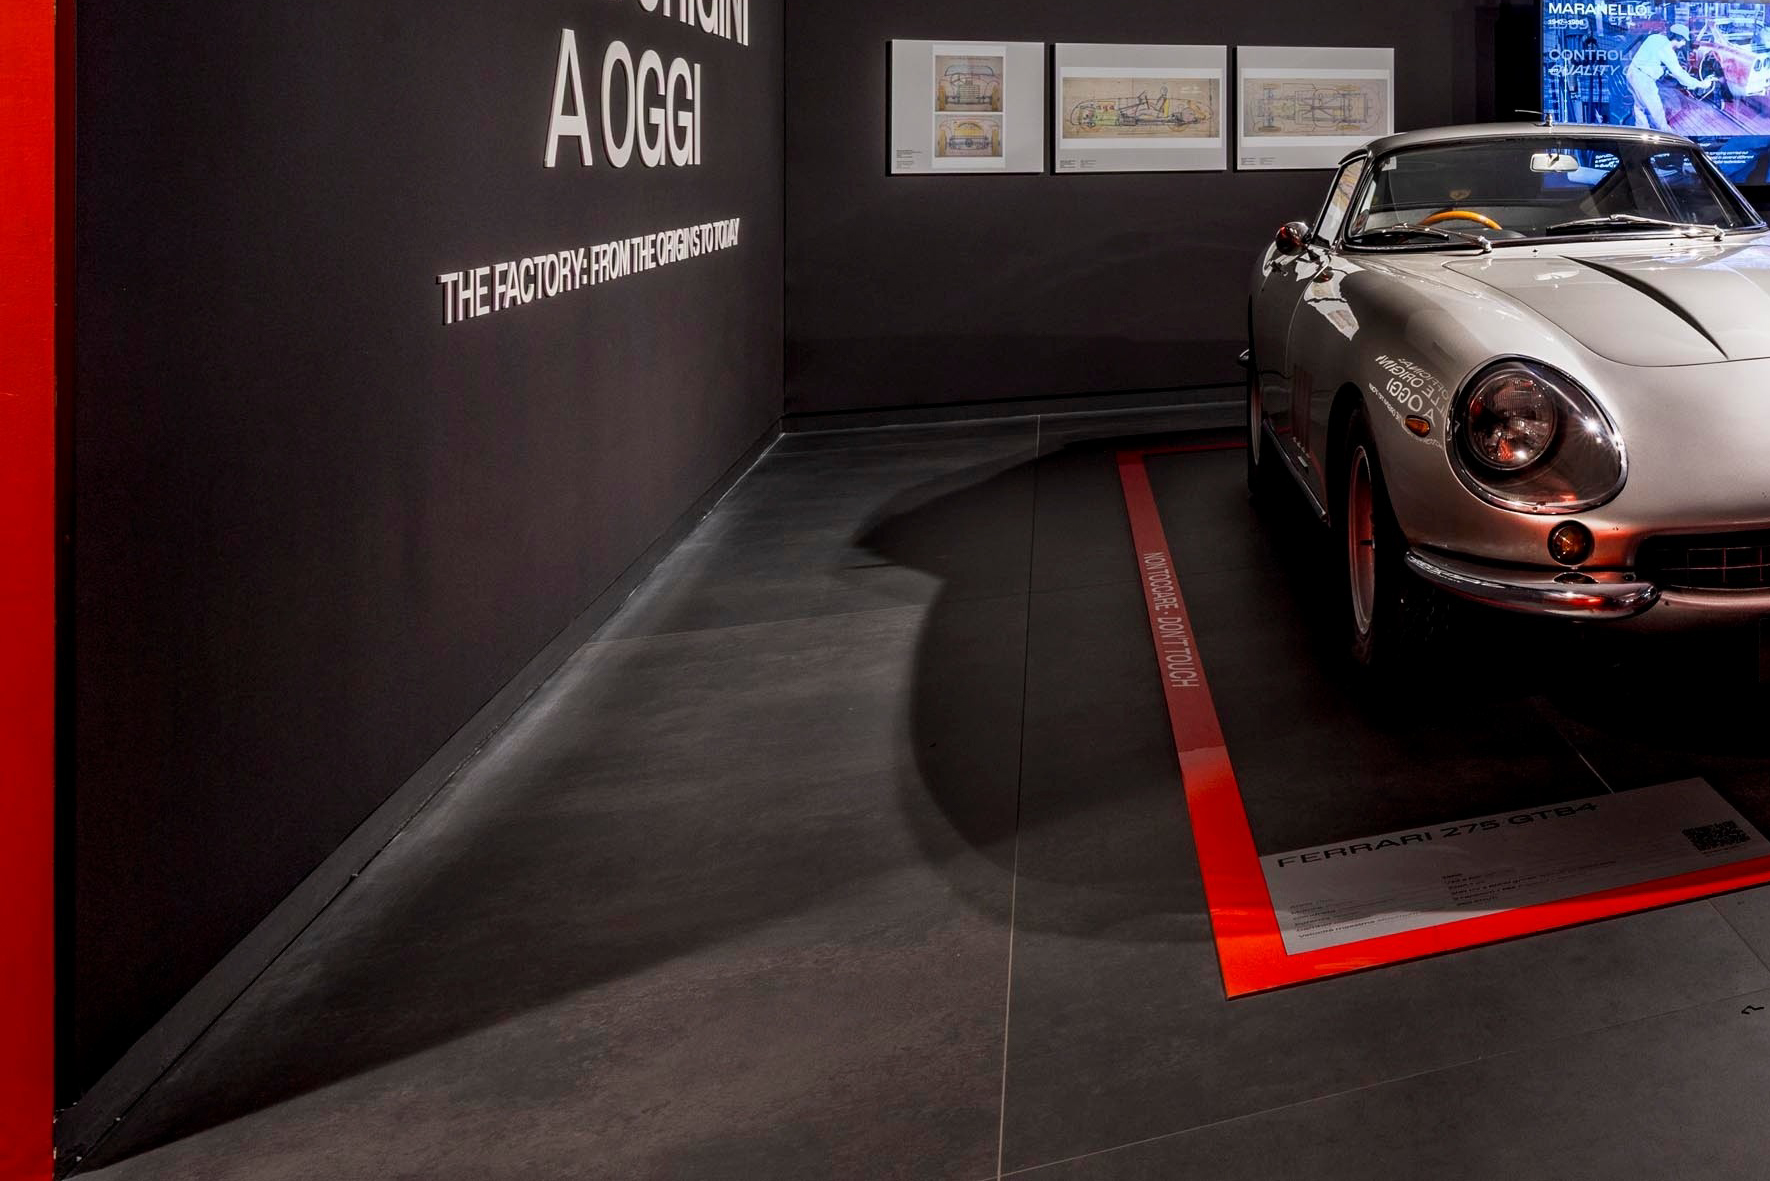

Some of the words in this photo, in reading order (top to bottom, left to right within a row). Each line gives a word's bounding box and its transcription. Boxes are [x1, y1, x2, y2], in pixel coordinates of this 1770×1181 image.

[1548, 2, 1647, 16] MARANELLO
[544, 29, 591, 168] A
[601, 40, 702, 168] OGGI
[437, 266, 490, 324] THE
[493, 248, 588, 311] FACTORY:
[590, 240, 631, 285] FROM
[631, 234, 656, 273] THE
[656, 225, 700, 266] ORIGINS
[700, 223, 713, 254] TO
[713, 218, 740, 250] TODAY
[1144, 552, 1167, 570] NON
[1149, 569, 1178, 611] TOCCARE
[1158, 617, 1188, 645] DON'T
[1165, 647, 1200, 688] TOUCH
[1277, 831, 1432, 867] FERRARI
[1441, 820, 1499, 838] 275
[1507, 803, 1597, 826] GTB4
